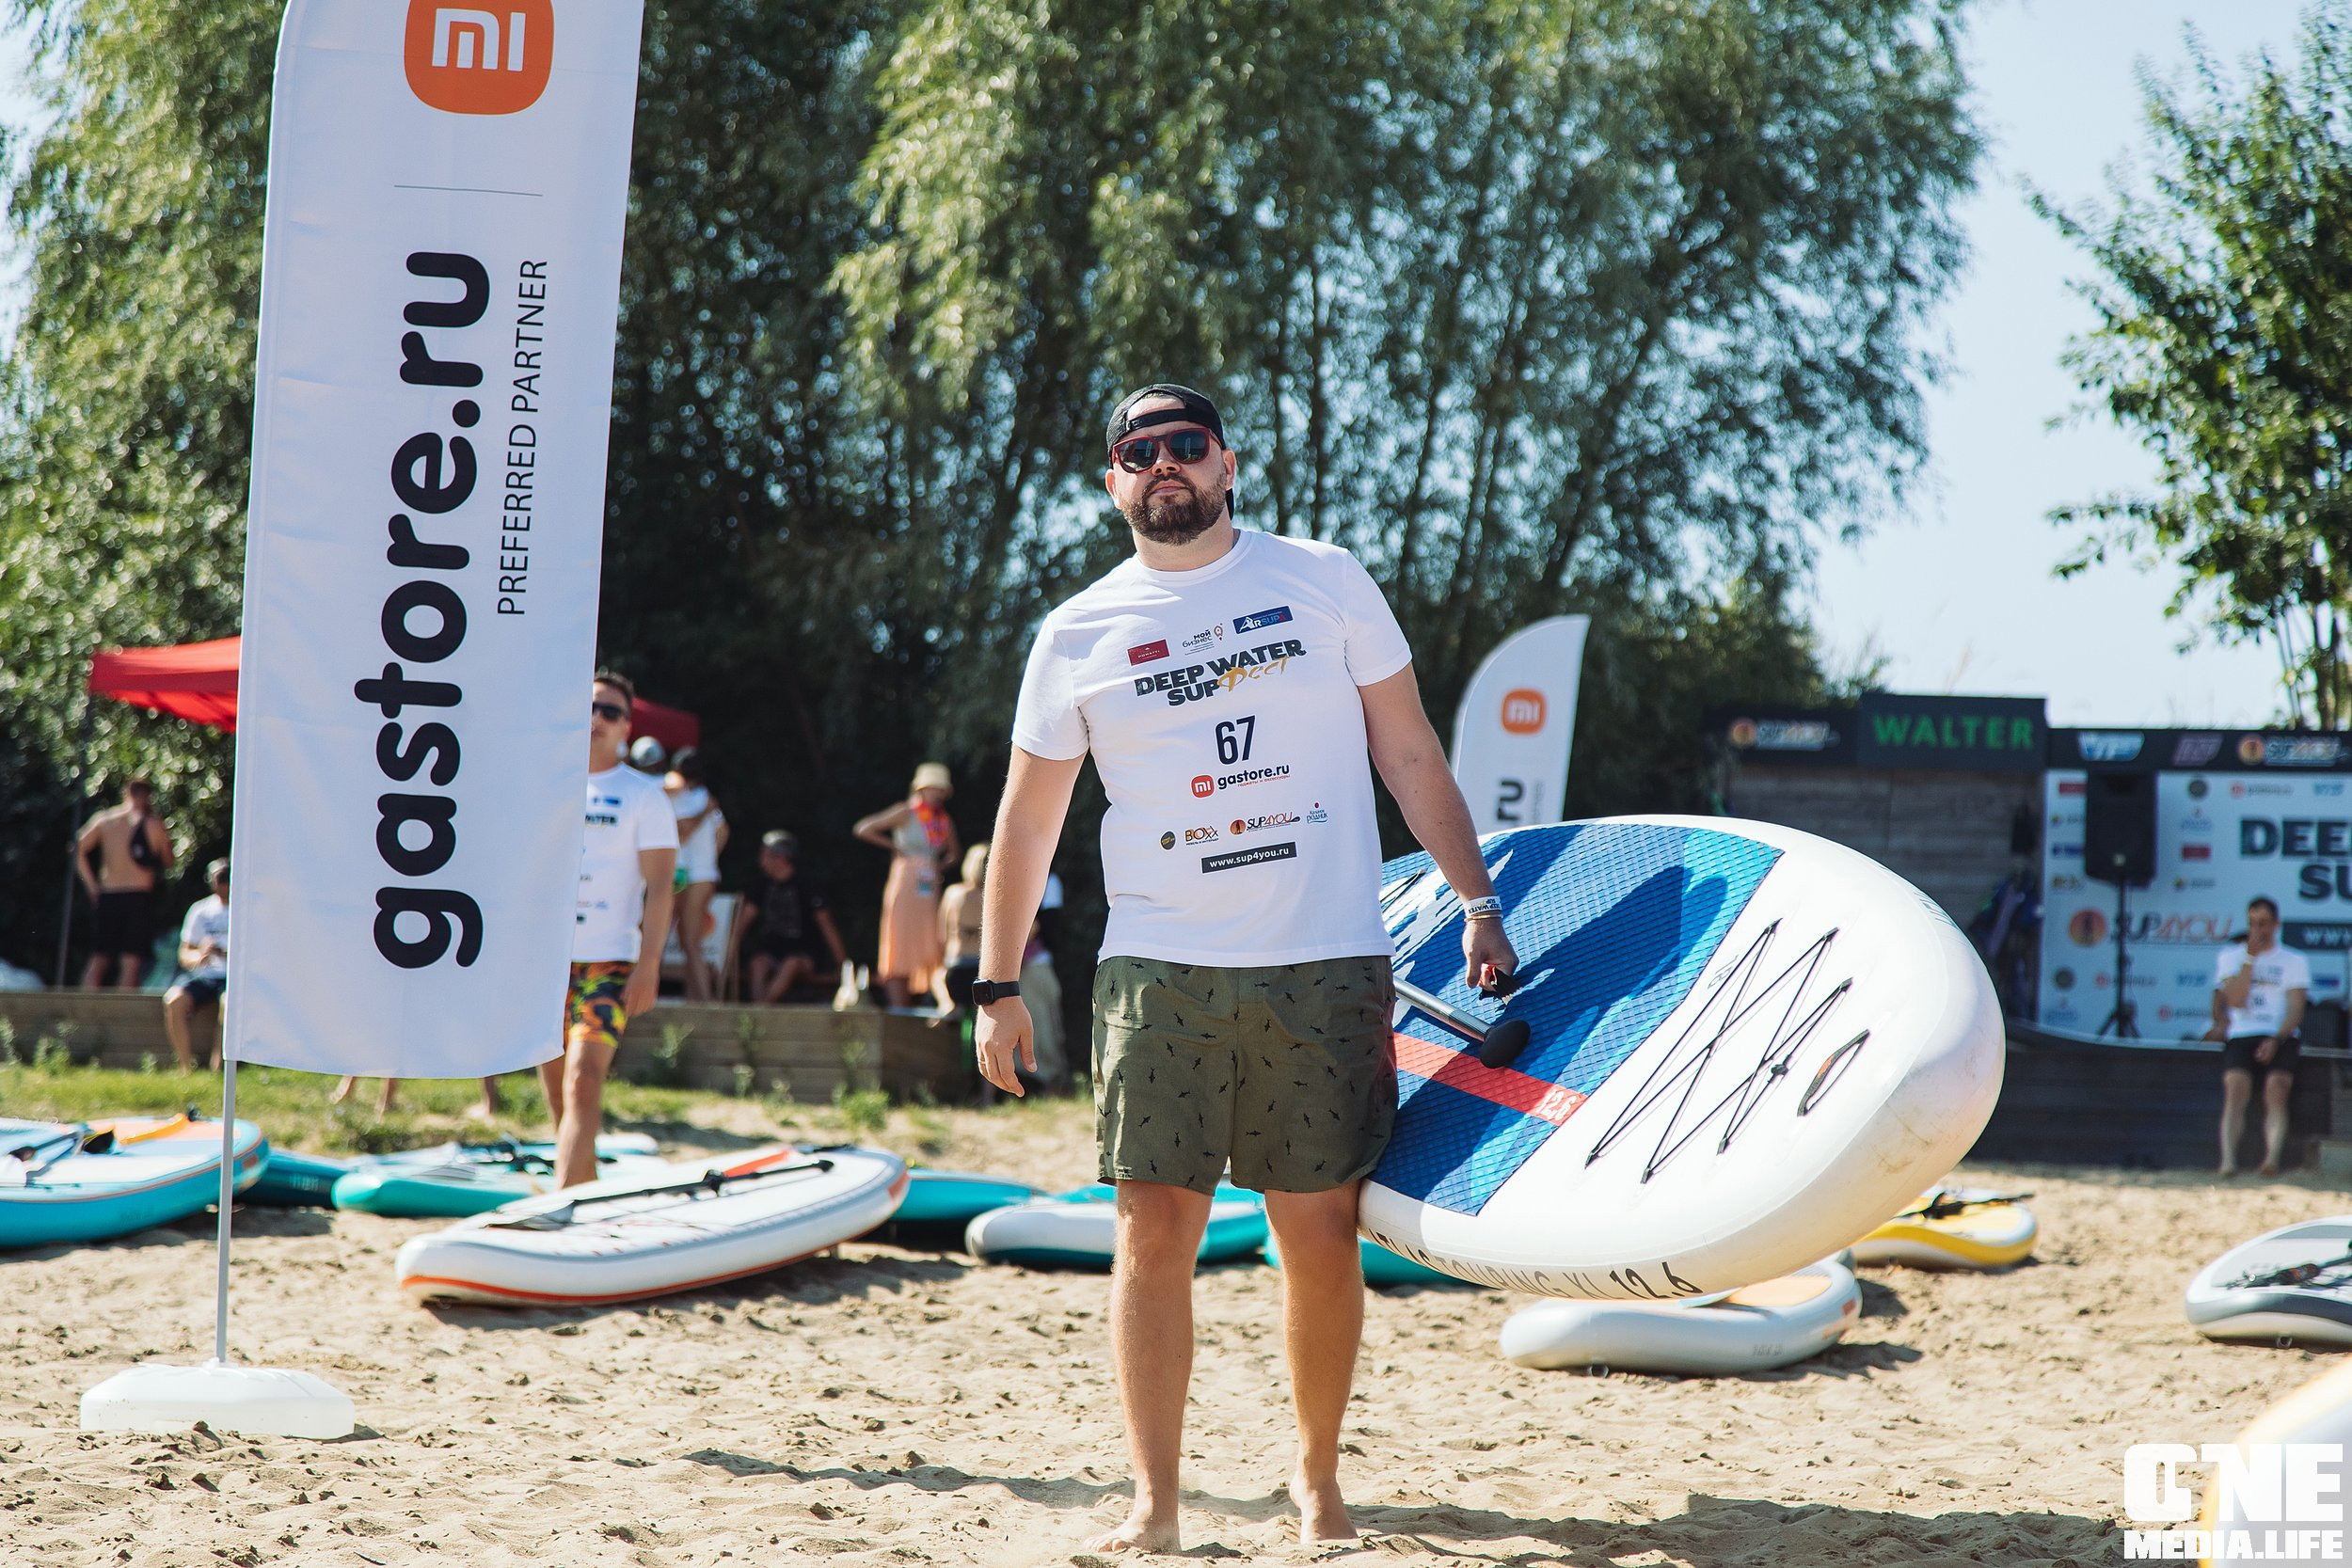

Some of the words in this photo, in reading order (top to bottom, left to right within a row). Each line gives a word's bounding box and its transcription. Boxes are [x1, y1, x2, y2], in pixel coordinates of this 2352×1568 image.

[511, 260, 548, 414] PARTNER
[497, 425, 537, 614] PREFERRED
[354, 252, 489, 969] gastore.ru
[1135, 664, 1204, 697] DEEP
[1206, 640, 1307, 677] WATER
[1168, 678, 1220, 706] SUP
[1216, 715, 1255, 765] 67
[1873, 714, 2034, 749] WALTER
[1217, 765, 1289, 790] gastore.ru
[1247, 812, 1293, 829] SUP4YOU
[2240, 819, 2351, 856] DEE
[1209, 847, 1289, 868] www.sup4you.ru
[2299, 863, 2352, 901] SU
[1435, 1255, 1574, 1299] TOURING
[1563, 1272, 1622, 1300] XL
[1609, 1261, 1704, 1300] 12.6
